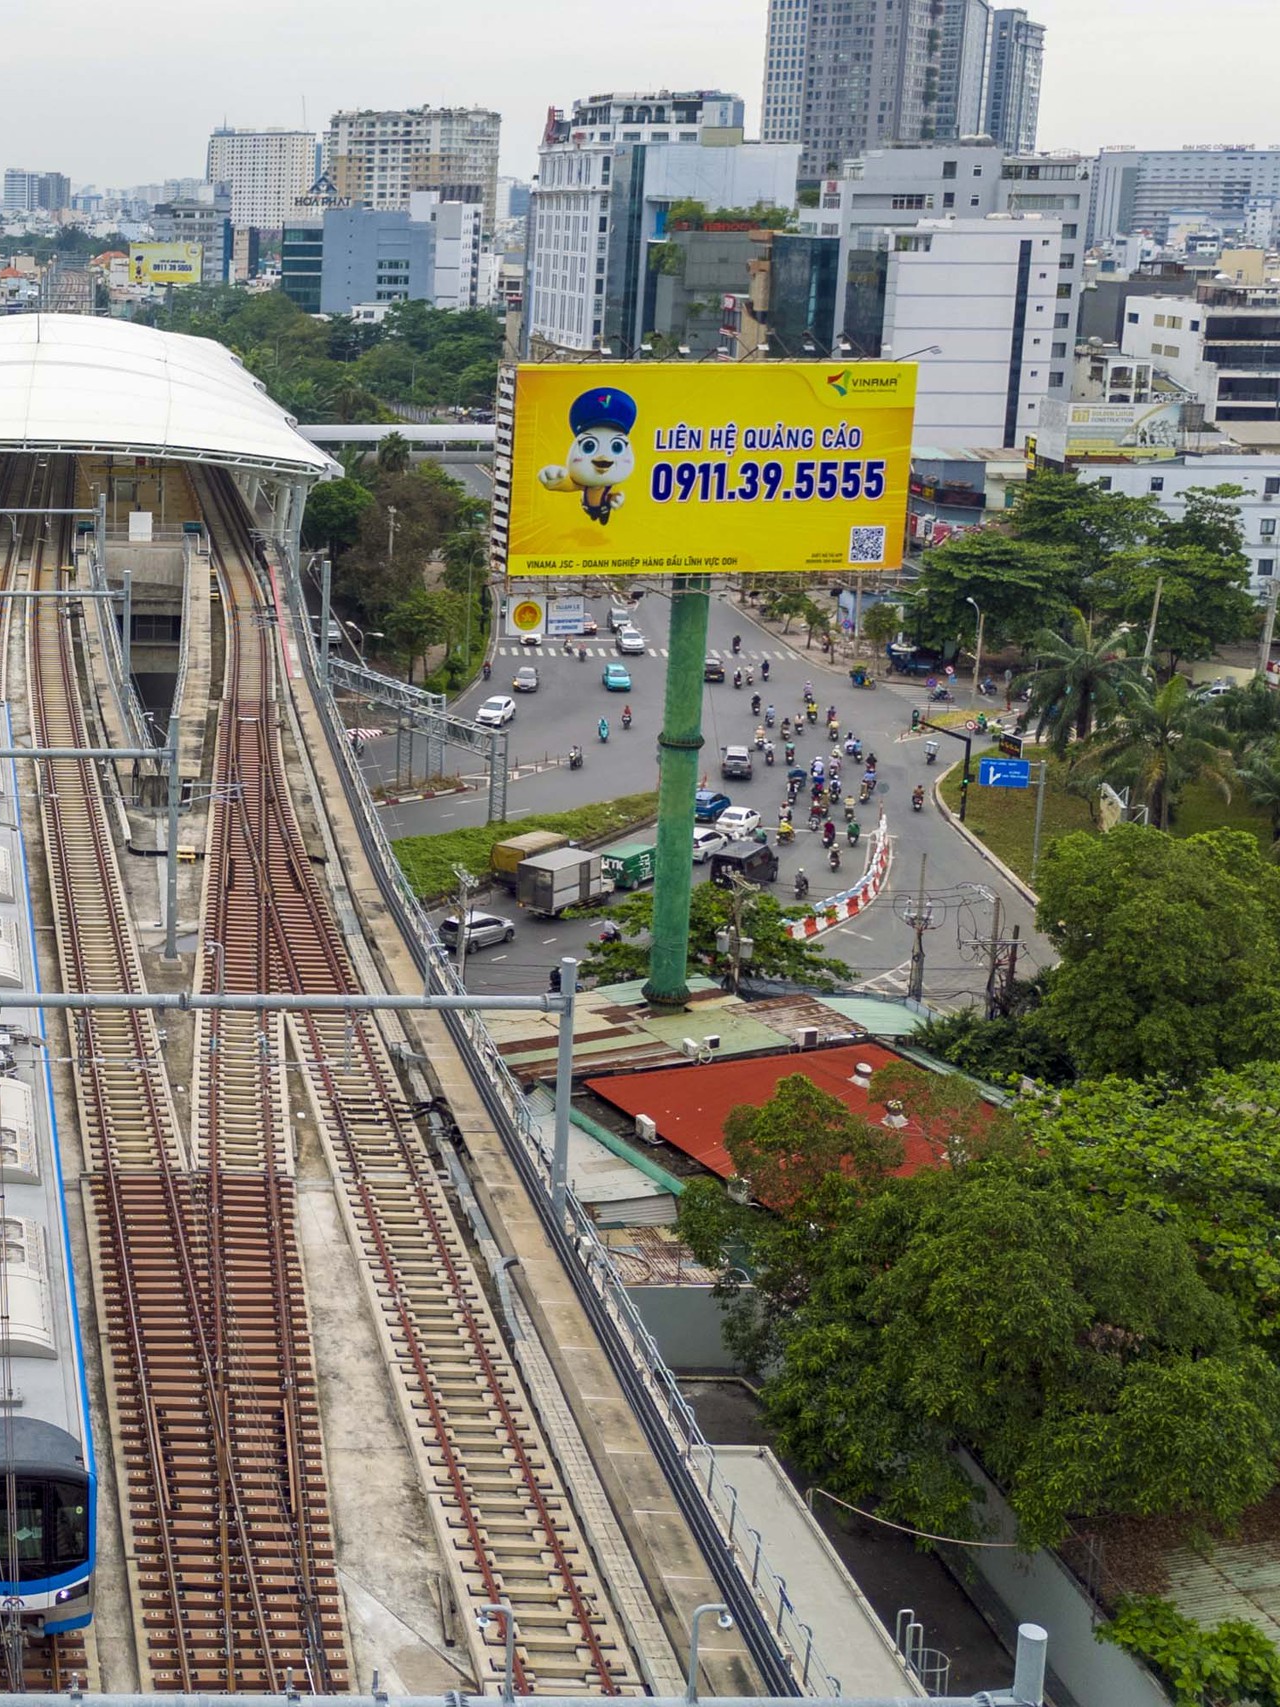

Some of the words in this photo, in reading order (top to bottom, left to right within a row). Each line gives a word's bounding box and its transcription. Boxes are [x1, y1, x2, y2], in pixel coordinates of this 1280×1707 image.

[654, 423, 703, 450] LIÊN
[709, 422, 737, 455] HỆ
[743, 422, 814, 450] QUẢNG
[821, 422, 862, 449] CÁO
[651, 461, 886, 501] 0911.39.5555
[526, 560, 557, 569] VINAMA
[558, 559, 574, 569] JSC
[582, 559, 609, 568] DOANH
[611, 556, 640, 569] NGHIỆP
[642, 556, 664, 567] HÀNG
